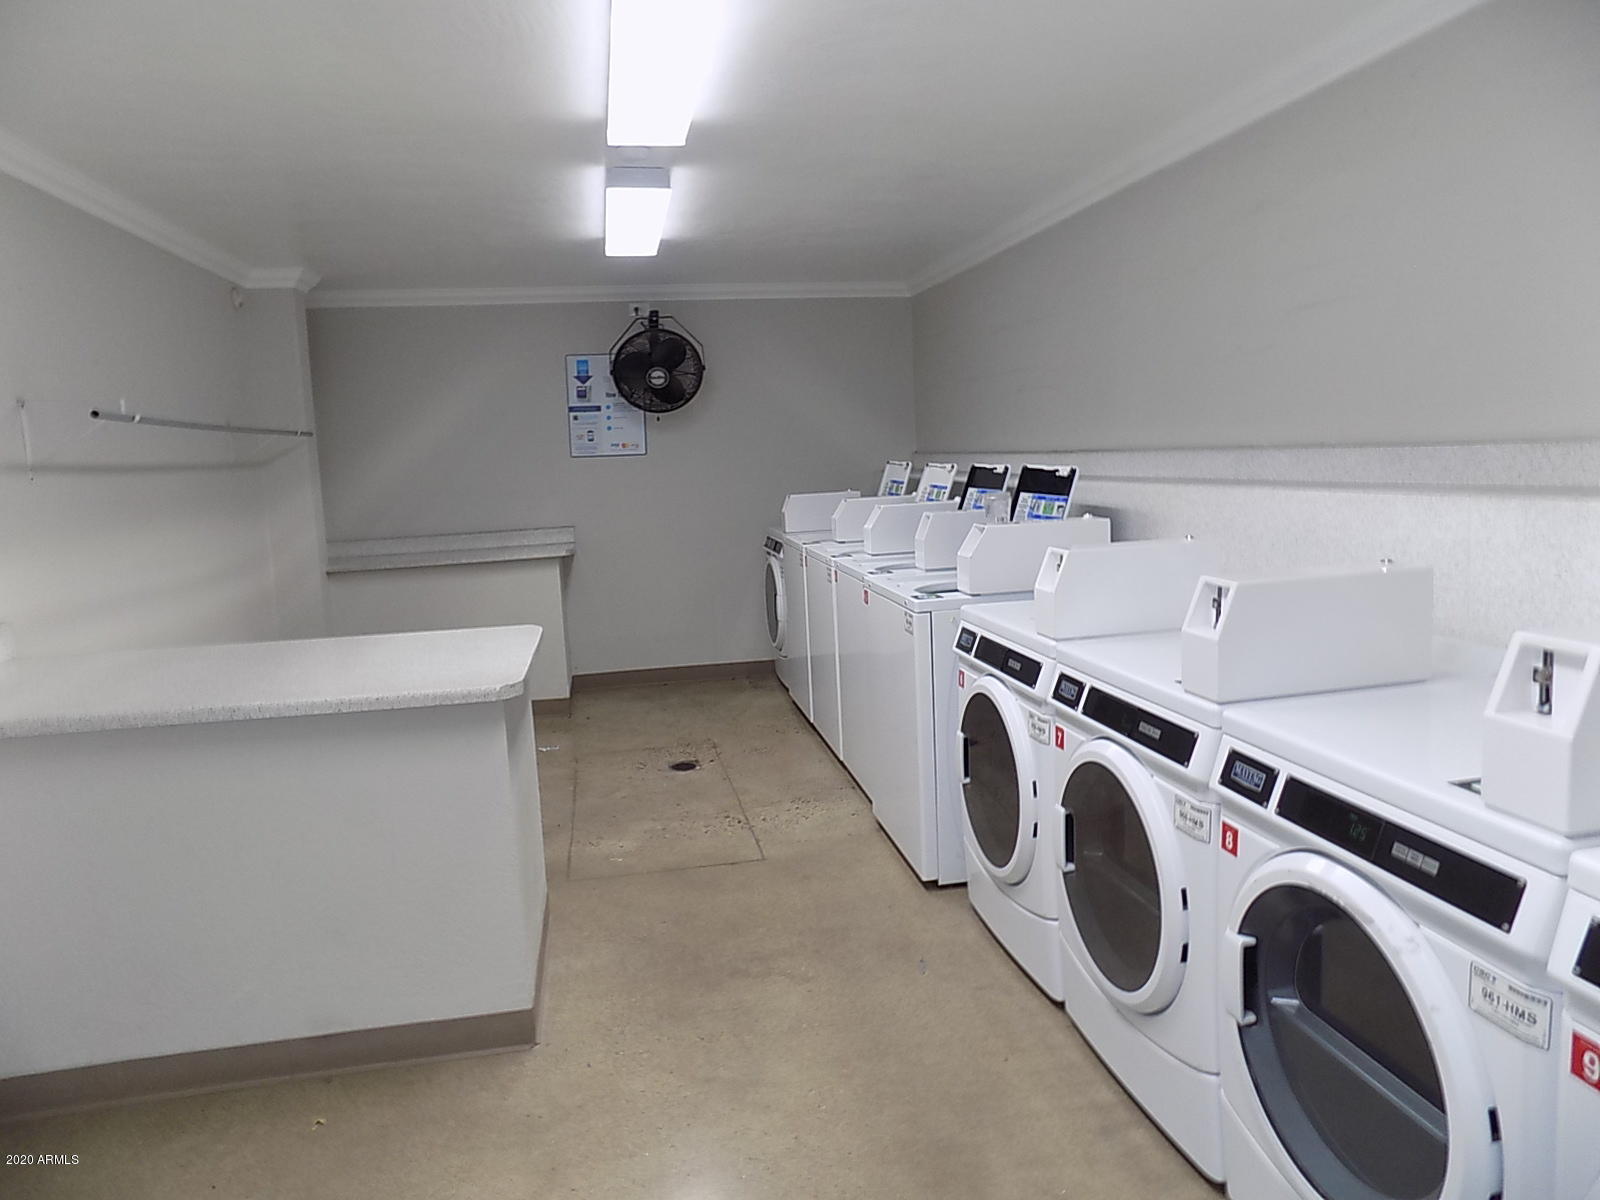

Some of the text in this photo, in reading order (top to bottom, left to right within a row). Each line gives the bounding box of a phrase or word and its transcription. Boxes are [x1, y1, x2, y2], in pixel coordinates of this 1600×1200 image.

[1056, 730, 1063, 745] 7
[1225, 830, 1233, 850] 8
[1582, 1050, 1600, 1084] 9
